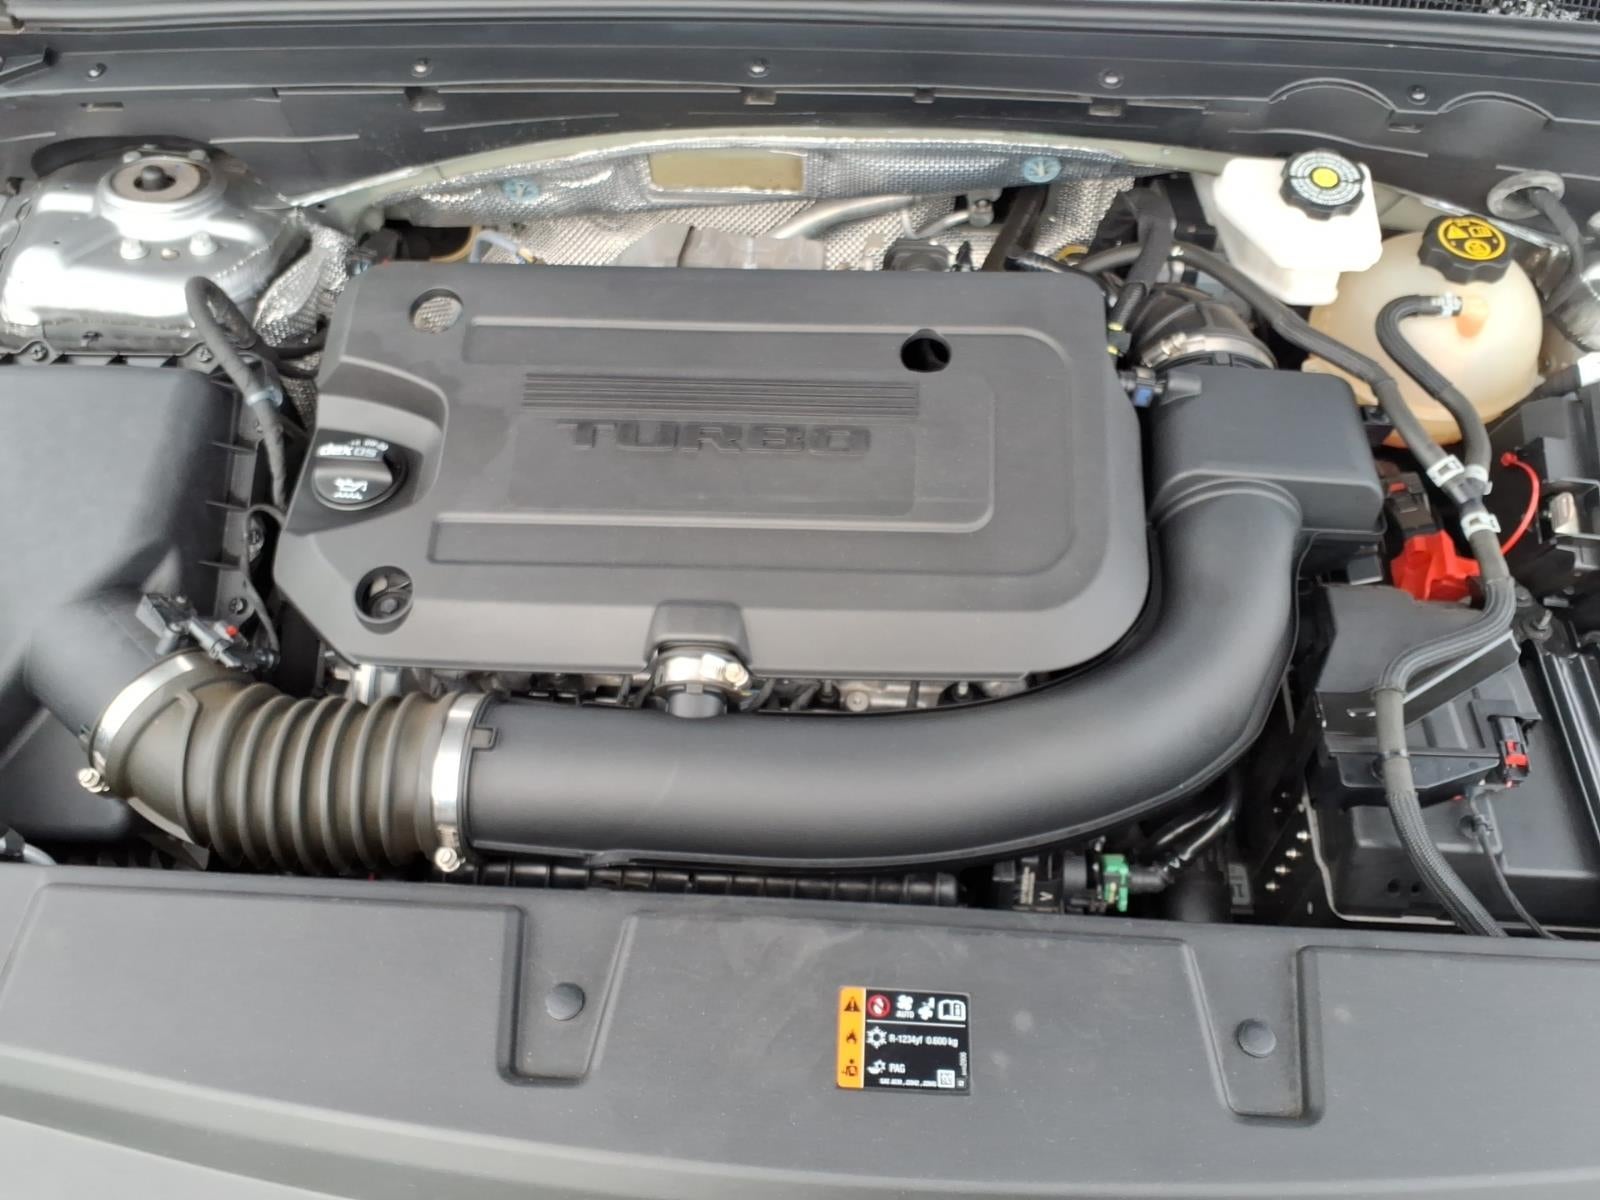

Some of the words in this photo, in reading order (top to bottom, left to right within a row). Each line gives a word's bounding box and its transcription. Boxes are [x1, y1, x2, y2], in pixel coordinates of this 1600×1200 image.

[557, 420, 871, 456] TURBO
[888, 1033, 923, 1046] R-1234yf
[948, 1037, 959, 1048] kg
[888, 1063, 906, 1074] PAG
